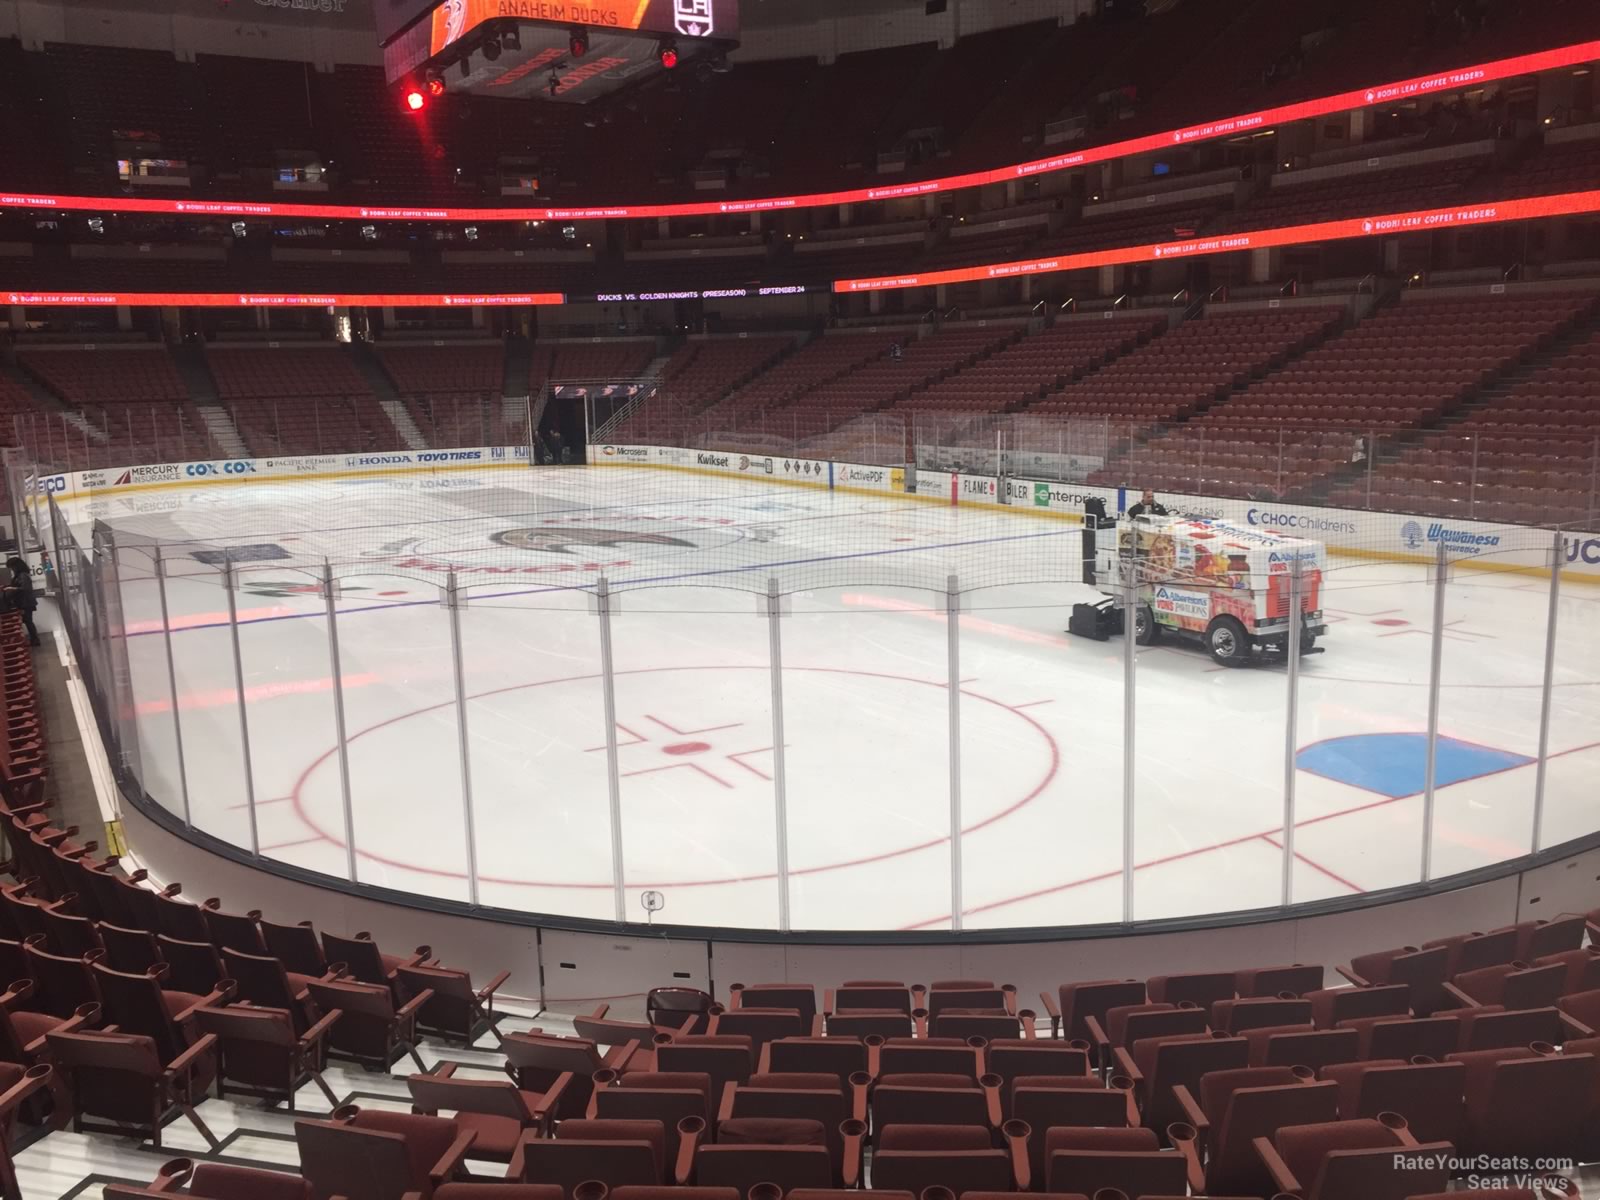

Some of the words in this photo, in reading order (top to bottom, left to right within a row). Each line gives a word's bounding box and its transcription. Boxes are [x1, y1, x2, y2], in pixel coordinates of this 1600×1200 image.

[498, 1, 565, 20] ANAHEIM
[571, 7, 618, 26] DUCKS
[1377, 88, 1399, 99] BODHI
[1421, 77, 1447, 89] COFFEE
[1450, 71, 1484, 82] TRADERS
[1215, 123, 1234, 132] COFFEE
[1237, 117, 1262, 127] TRADERS
[1376, 219, 1400, 229] BODHI
[1402, 217, 1421, 226] LEAF
[1424, 213, 1453, 224] COFFEE
[1457, 209, 1496, 219] TRADERS
[1163, 246, 1180, 254] BODHI
[1199, 241, 1219, 250] COFFEE
[1222, 238, 1249, 247] TRADERS
[639, 292, 668, 300] GOLDEN
[669, 291, 698, 299] KNIGHTS
[702, 289, 746, 298] (PRESEASON)
[759, 286, 797, 295] SEPTEMBER
[417, 452, 448, 462] TOYO
[449, 451, 481, 460] TIRES
[491, 447, 505, 457] FIJI
[359, 455, 412, 465] HONDA
[697, 453, 728, 467] Kwikset
[132, 465, 179, 477] MERCURY
[186, 463, 219, 476] COX
[223, 462, 256, 474] COX
[850, 468, 884, 483] ActivePDF
[133, 474, 181, 483] INSURANCE
[964, 479, 988, 495] FLAME
[1192, 506, 1224, 518] CASINO
[1261, 512, 1297, 527] CHOC
[1298, 516, 1356, 534] Children's
[1427, 523, 1500, 545] Wawanesa
